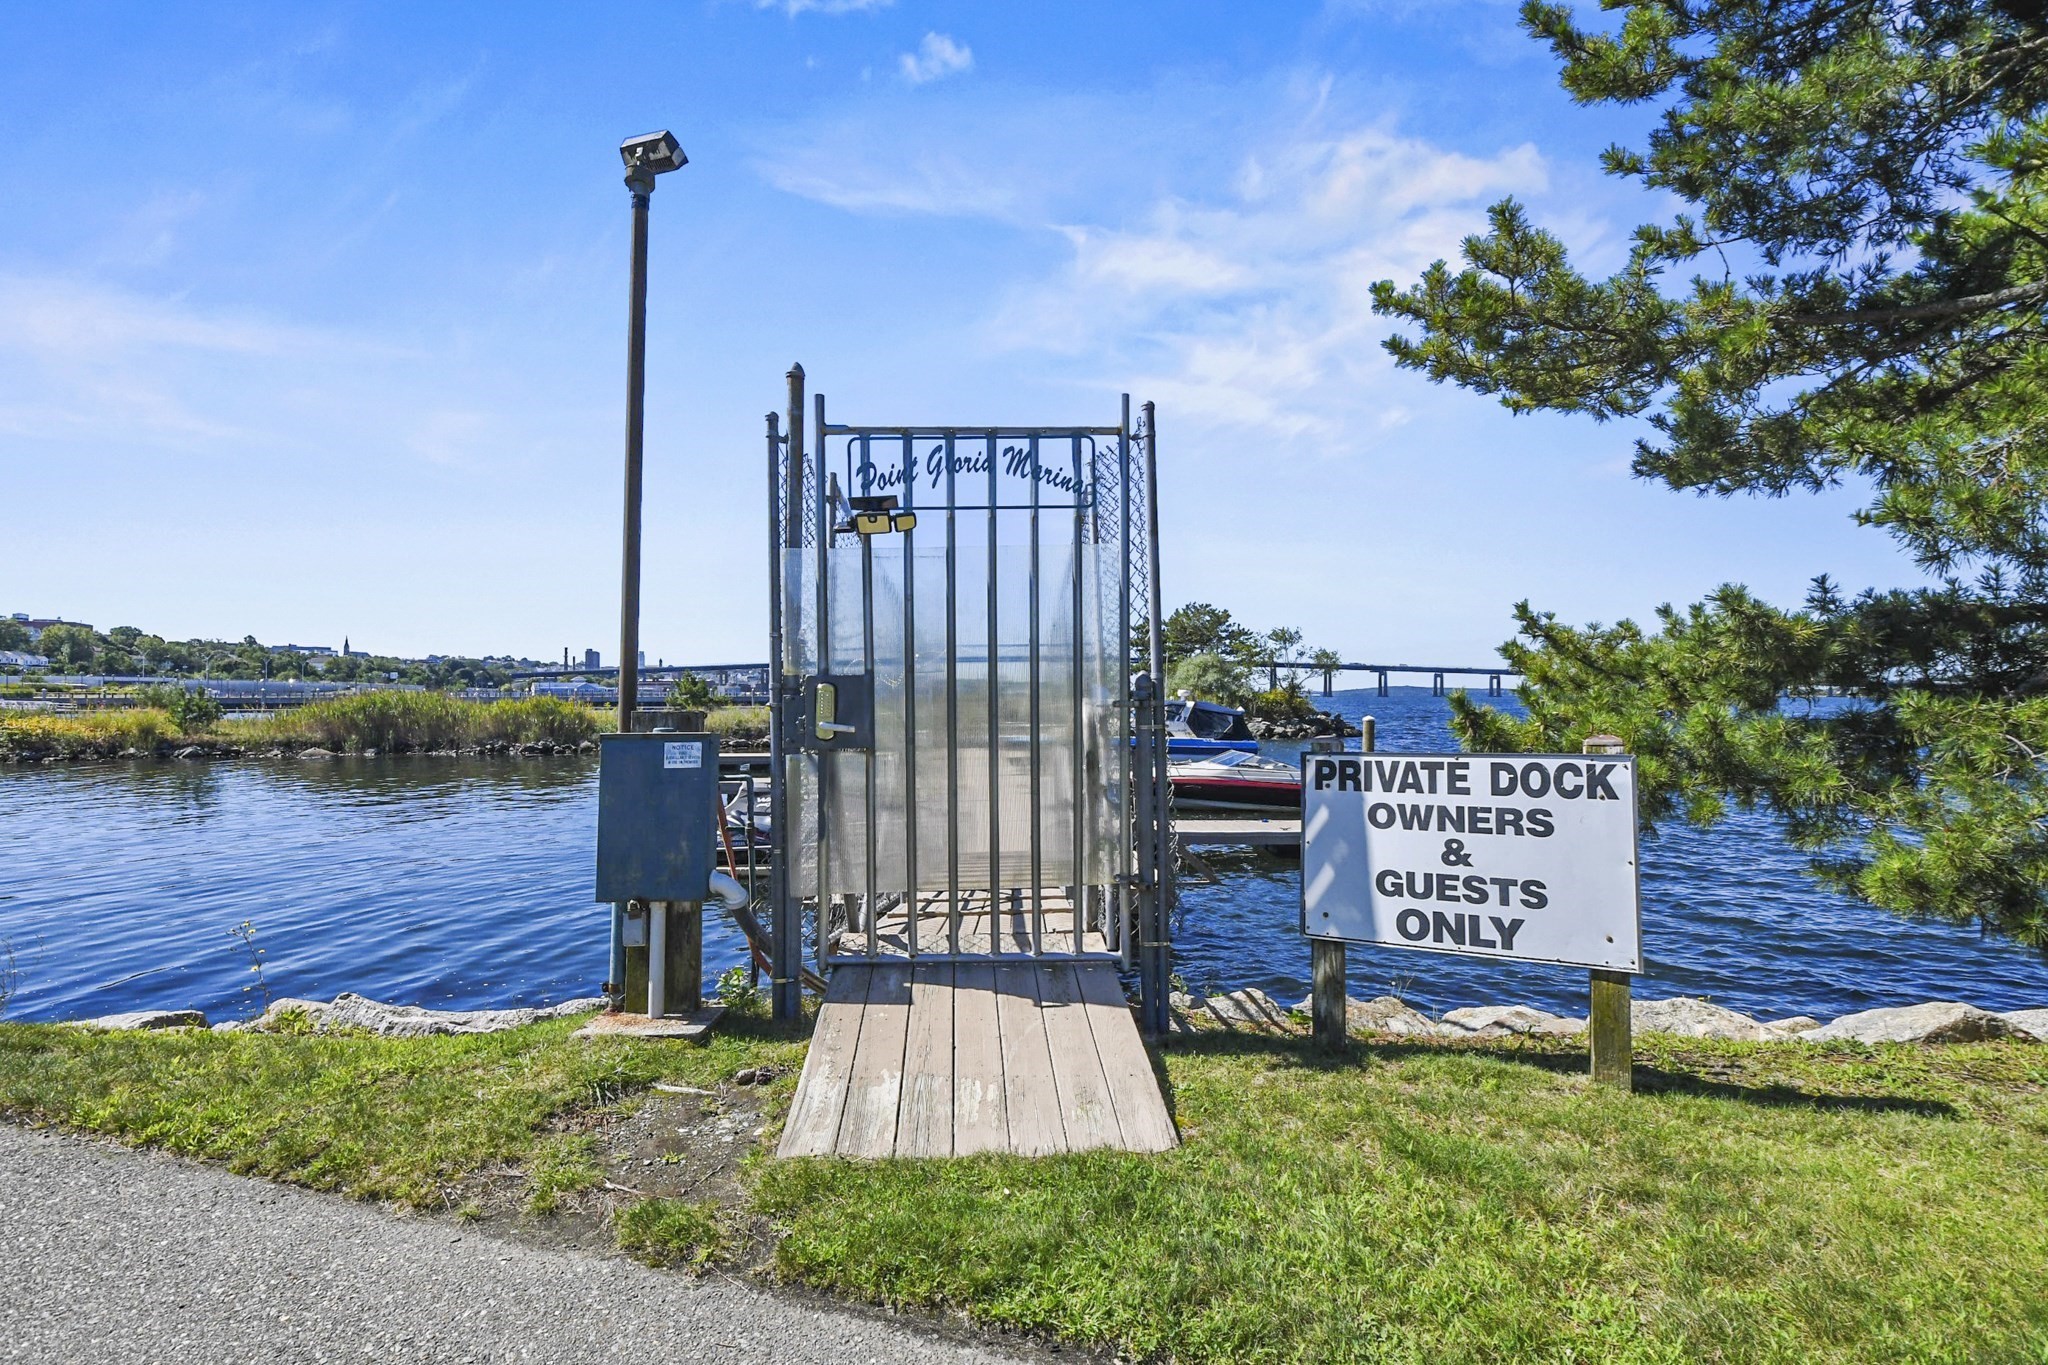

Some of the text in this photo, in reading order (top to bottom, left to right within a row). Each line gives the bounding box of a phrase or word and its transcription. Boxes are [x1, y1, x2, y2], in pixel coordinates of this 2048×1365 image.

[856, 455, 919, 491] Point
[1002, 445, 1085, 496] Marina
[1315, 760, 1619, 800] PRIVATE DOCK
[1368, 802, 1554, 837] OWNERS
[1441, 838, 1474, 867] &
[1375, 869, 1548, 909] GUESTS
[1396, 908, 1525, 950] ONLY
